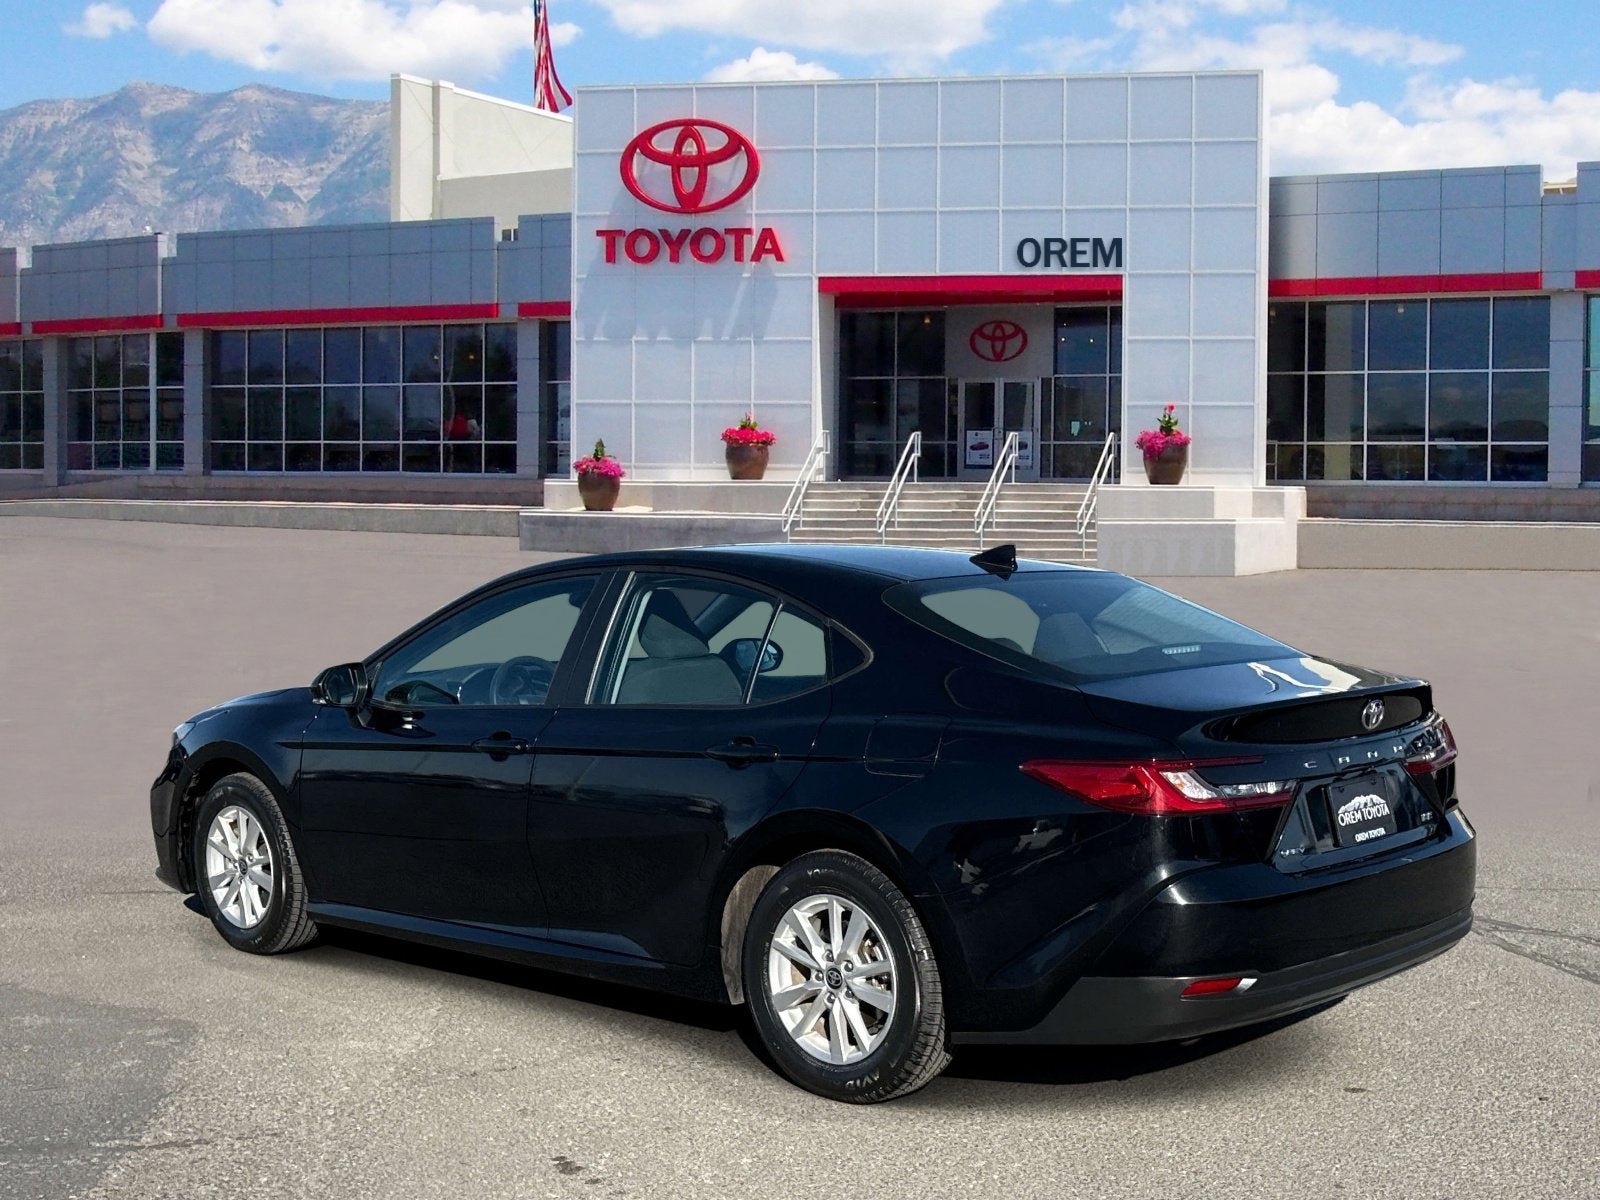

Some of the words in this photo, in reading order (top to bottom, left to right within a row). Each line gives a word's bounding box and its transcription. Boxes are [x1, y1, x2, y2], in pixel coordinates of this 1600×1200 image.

[596, 227, 785, 264] TOYOTA
[1017, 237, 1123, 268] OREM
[1338, 809, 1363, 827] OREM
[1362, 803, 1390, 820] TOYOTA
[1355, 832, 1369, 842] OREM
[1368, 827, 1386, 839] TOYOTA
